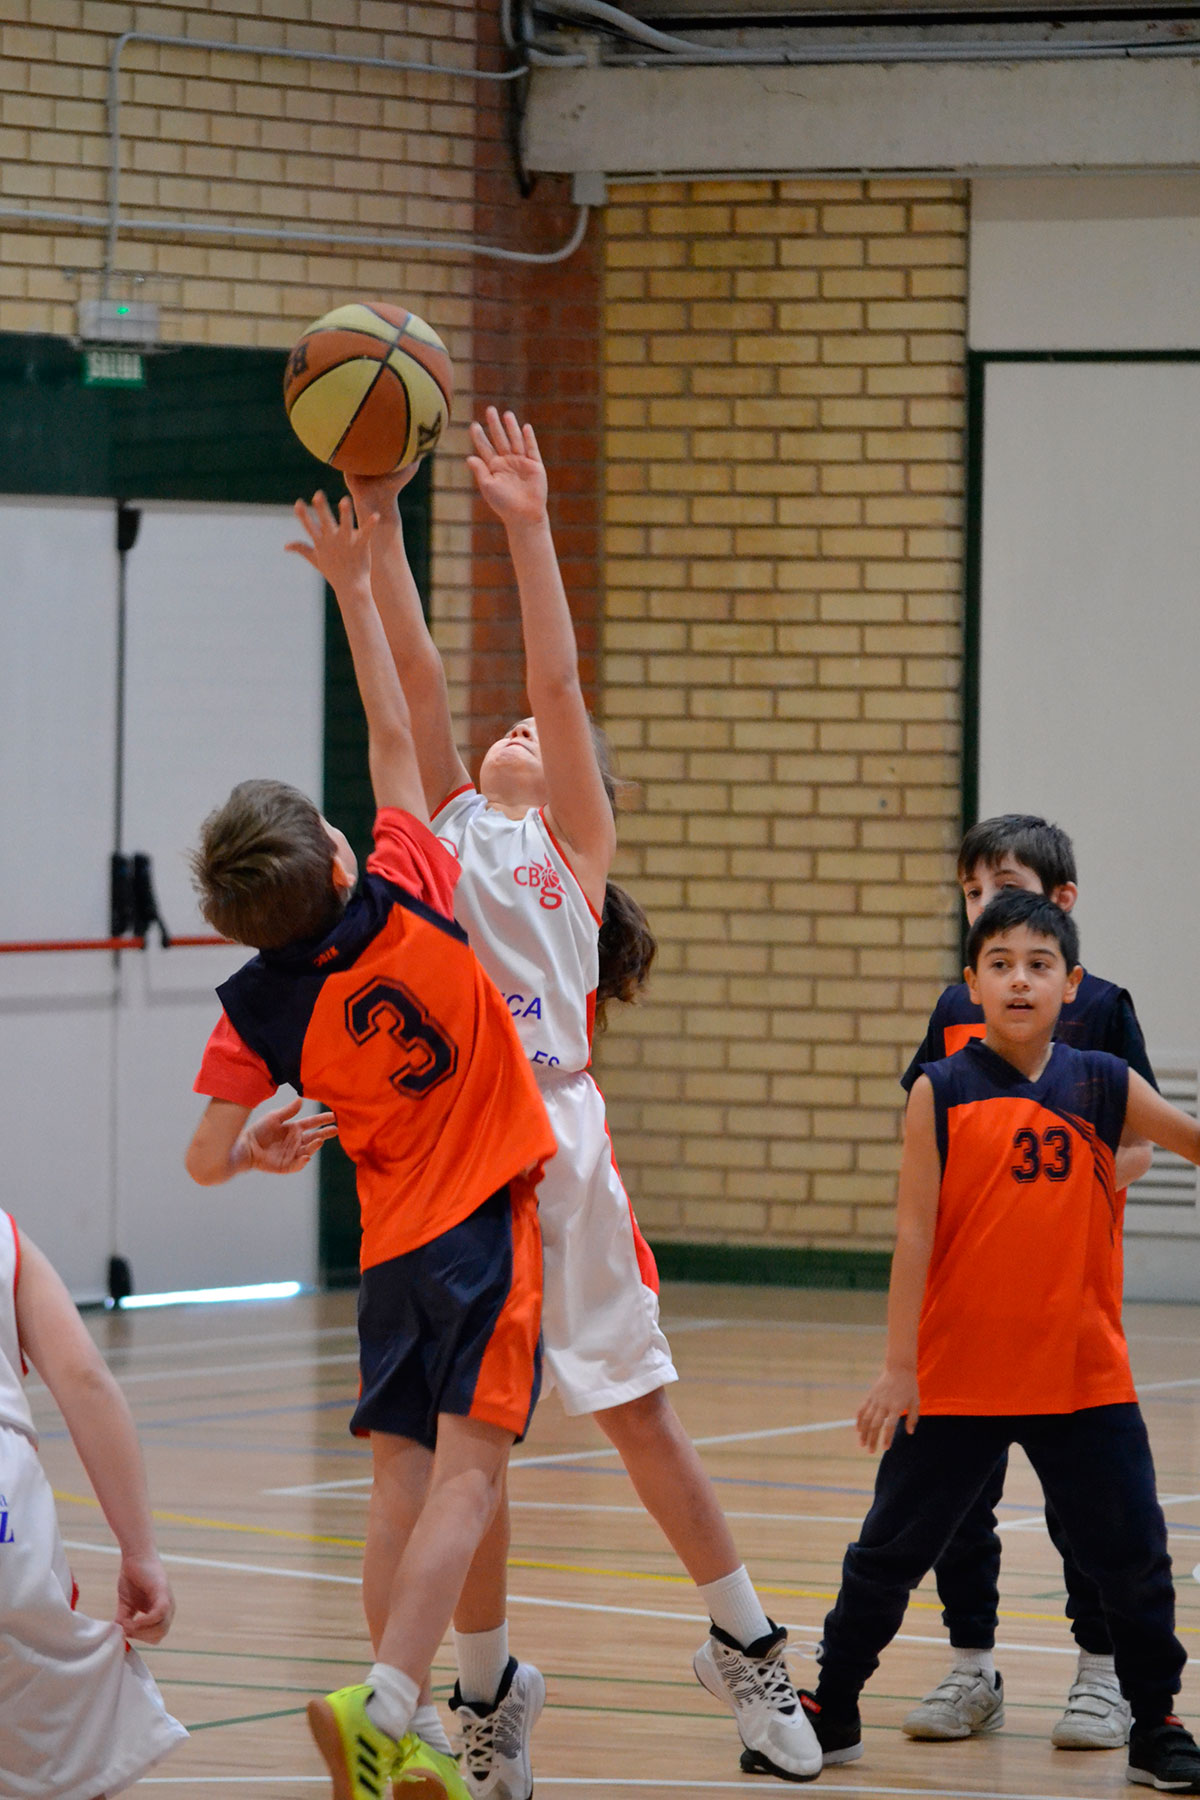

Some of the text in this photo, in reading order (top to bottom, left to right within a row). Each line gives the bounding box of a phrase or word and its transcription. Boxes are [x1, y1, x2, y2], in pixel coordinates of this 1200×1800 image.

[501, 993, 542, 1020] CA
[345, 975, 459, 1100] 3
[1011, 1126, 1073, 1184] 33
